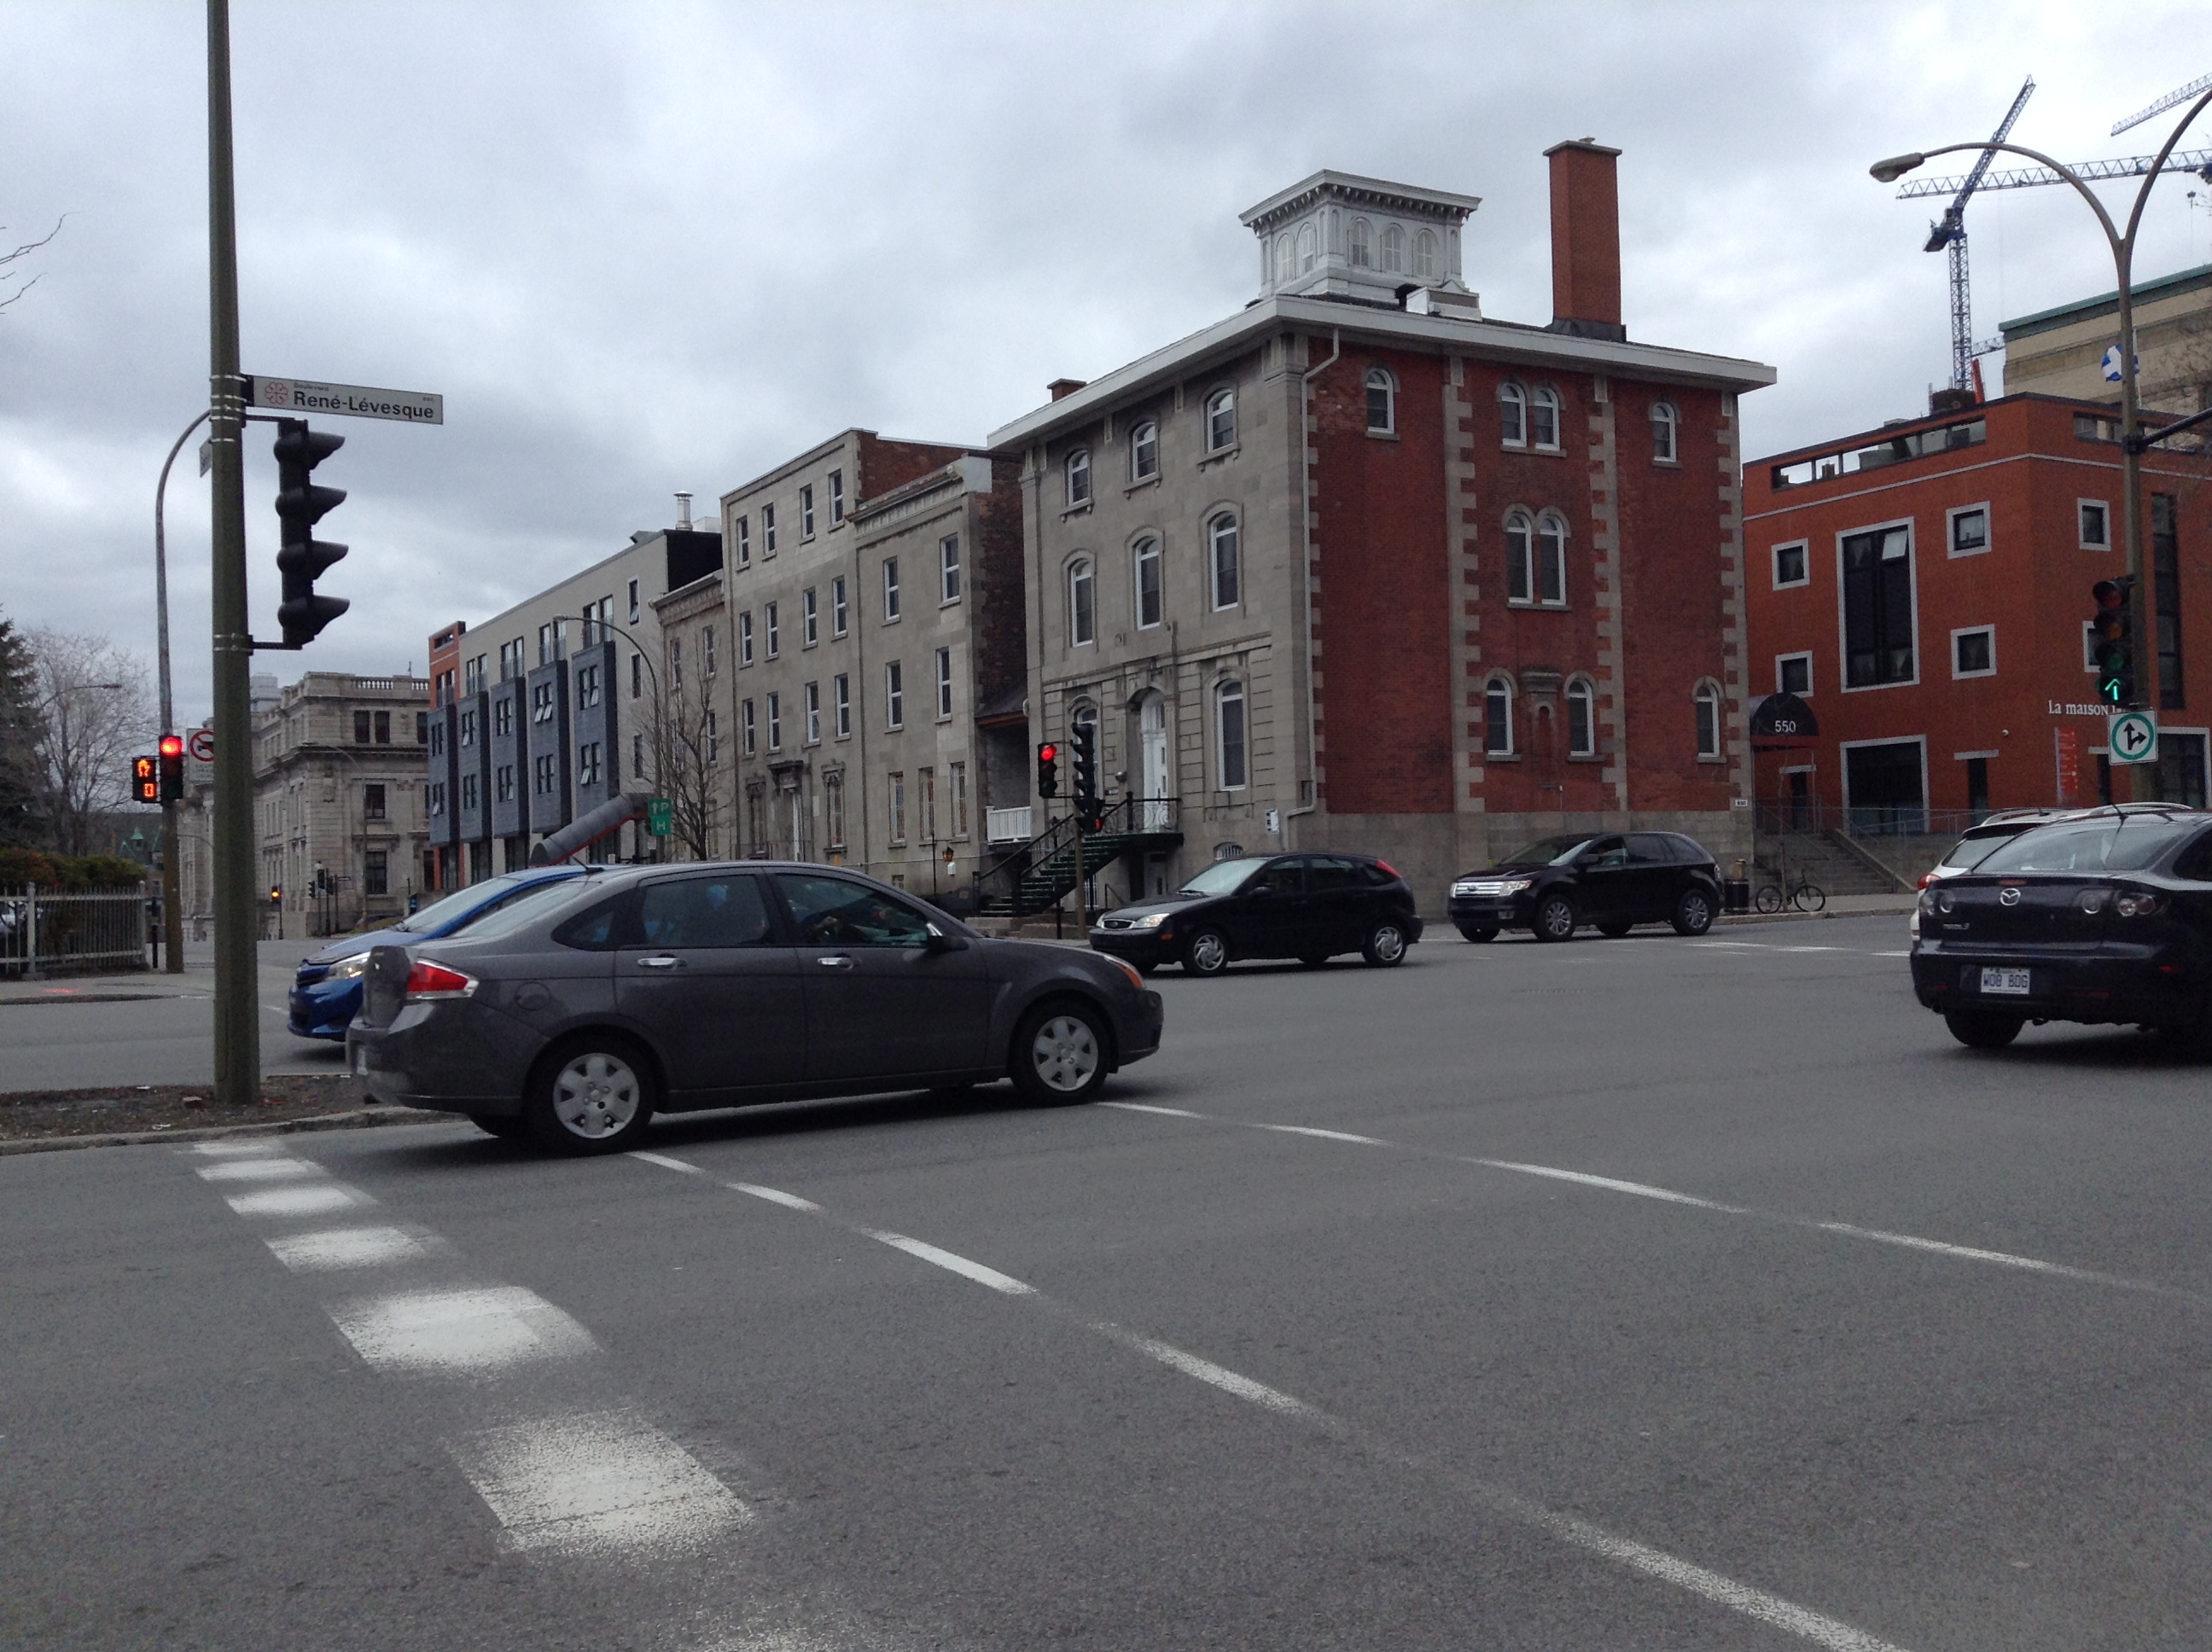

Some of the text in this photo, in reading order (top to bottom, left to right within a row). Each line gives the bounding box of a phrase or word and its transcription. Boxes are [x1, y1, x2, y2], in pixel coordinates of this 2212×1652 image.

[294, 390, 434, 419] René-Lévesque
[2048, 700, 2062, 714] La
[1775, 719, 1796, 733] 550
[661, 802, 670, 812] P
[656, 820, 666, 830] H
